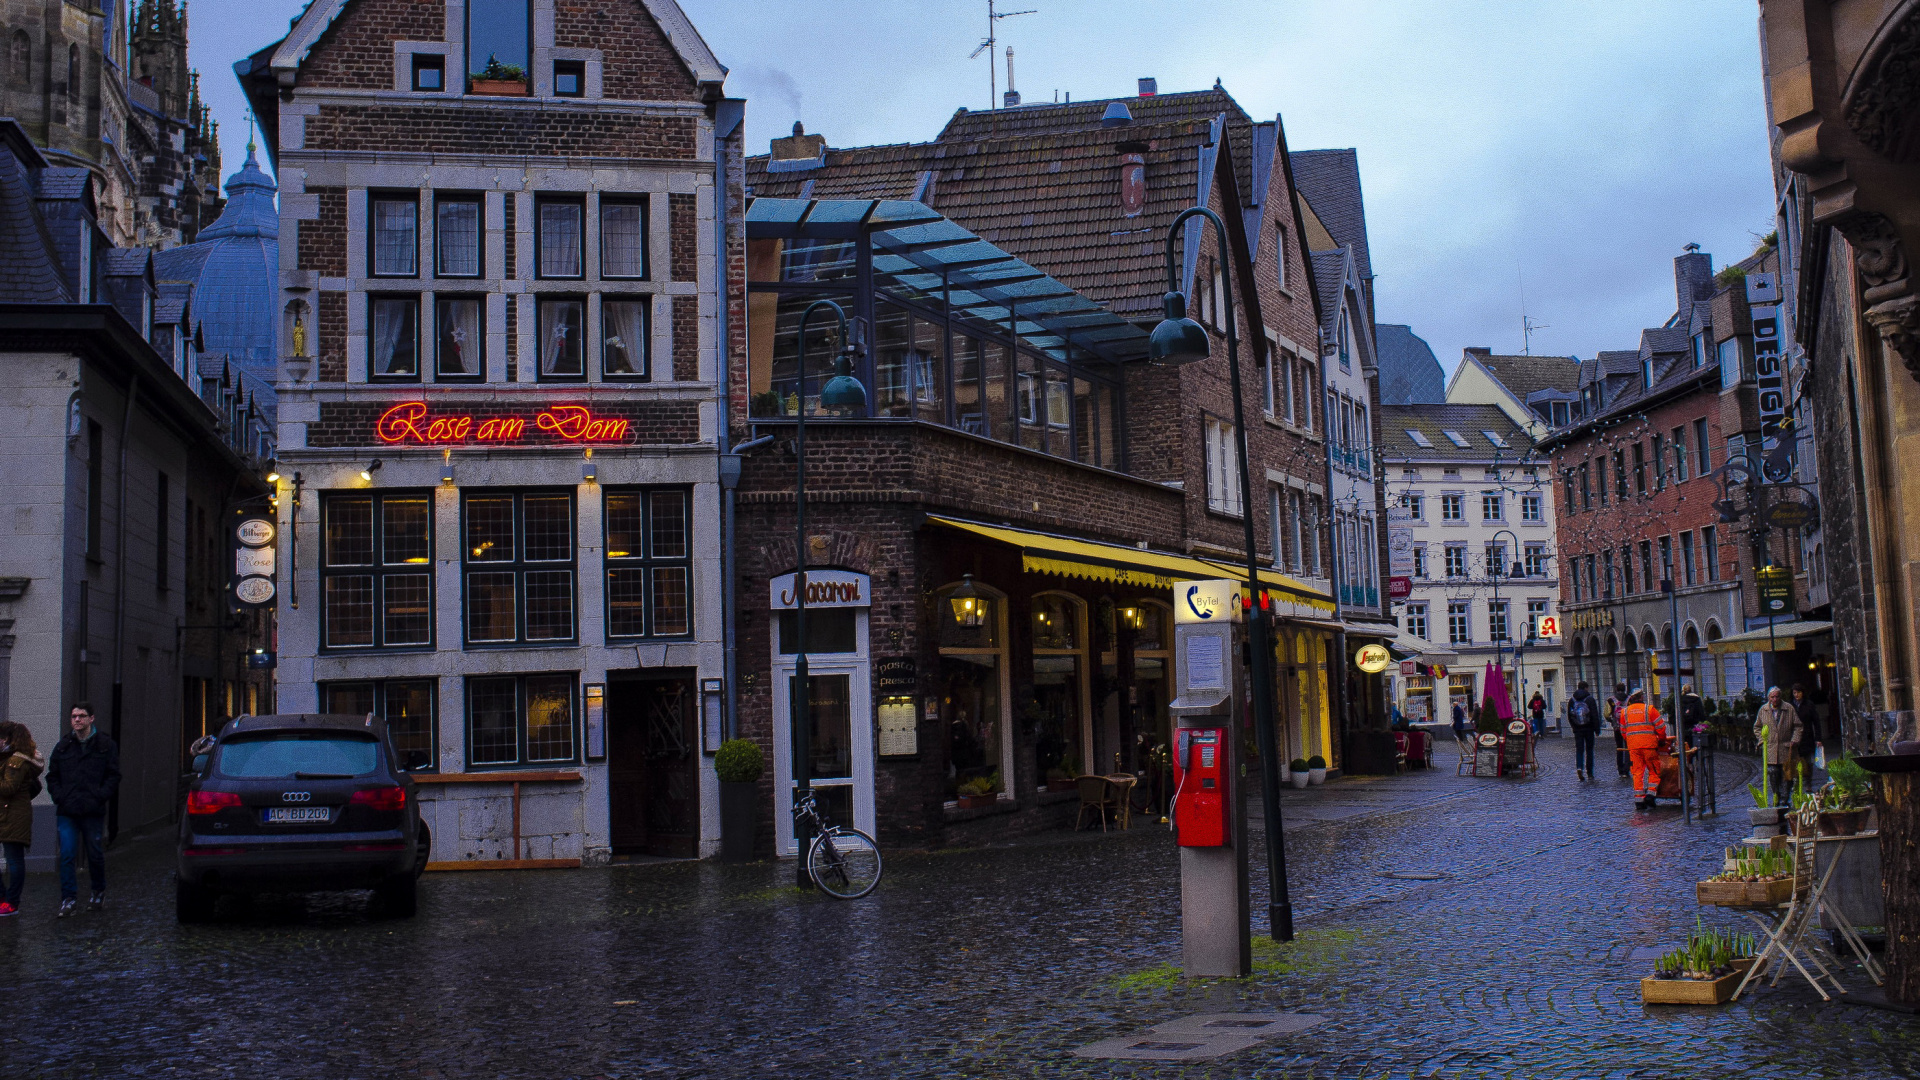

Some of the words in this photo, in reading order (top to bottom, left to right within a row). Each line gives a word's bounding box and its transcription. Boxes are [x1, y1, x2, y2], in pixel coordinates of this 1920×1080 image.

[1753, 317, 1785, 438] DESIGN
[378, 402, 471, 442] Rose
[477, 418, 524, 439] am
[537, 406, 628, 439] Dom
[242, 527, 270, 538] Bitburger
[781, 572, 862, 606] Macaroni
[1196, 596, 1219, 608] ByTel
[1541, 616, 1557, 635] A
[879, 661, 914, 674] pasta
[270, 808, 283, 819] AC
[290, 808, 305, 819] BD
[307, 808, 328, 819] 209
